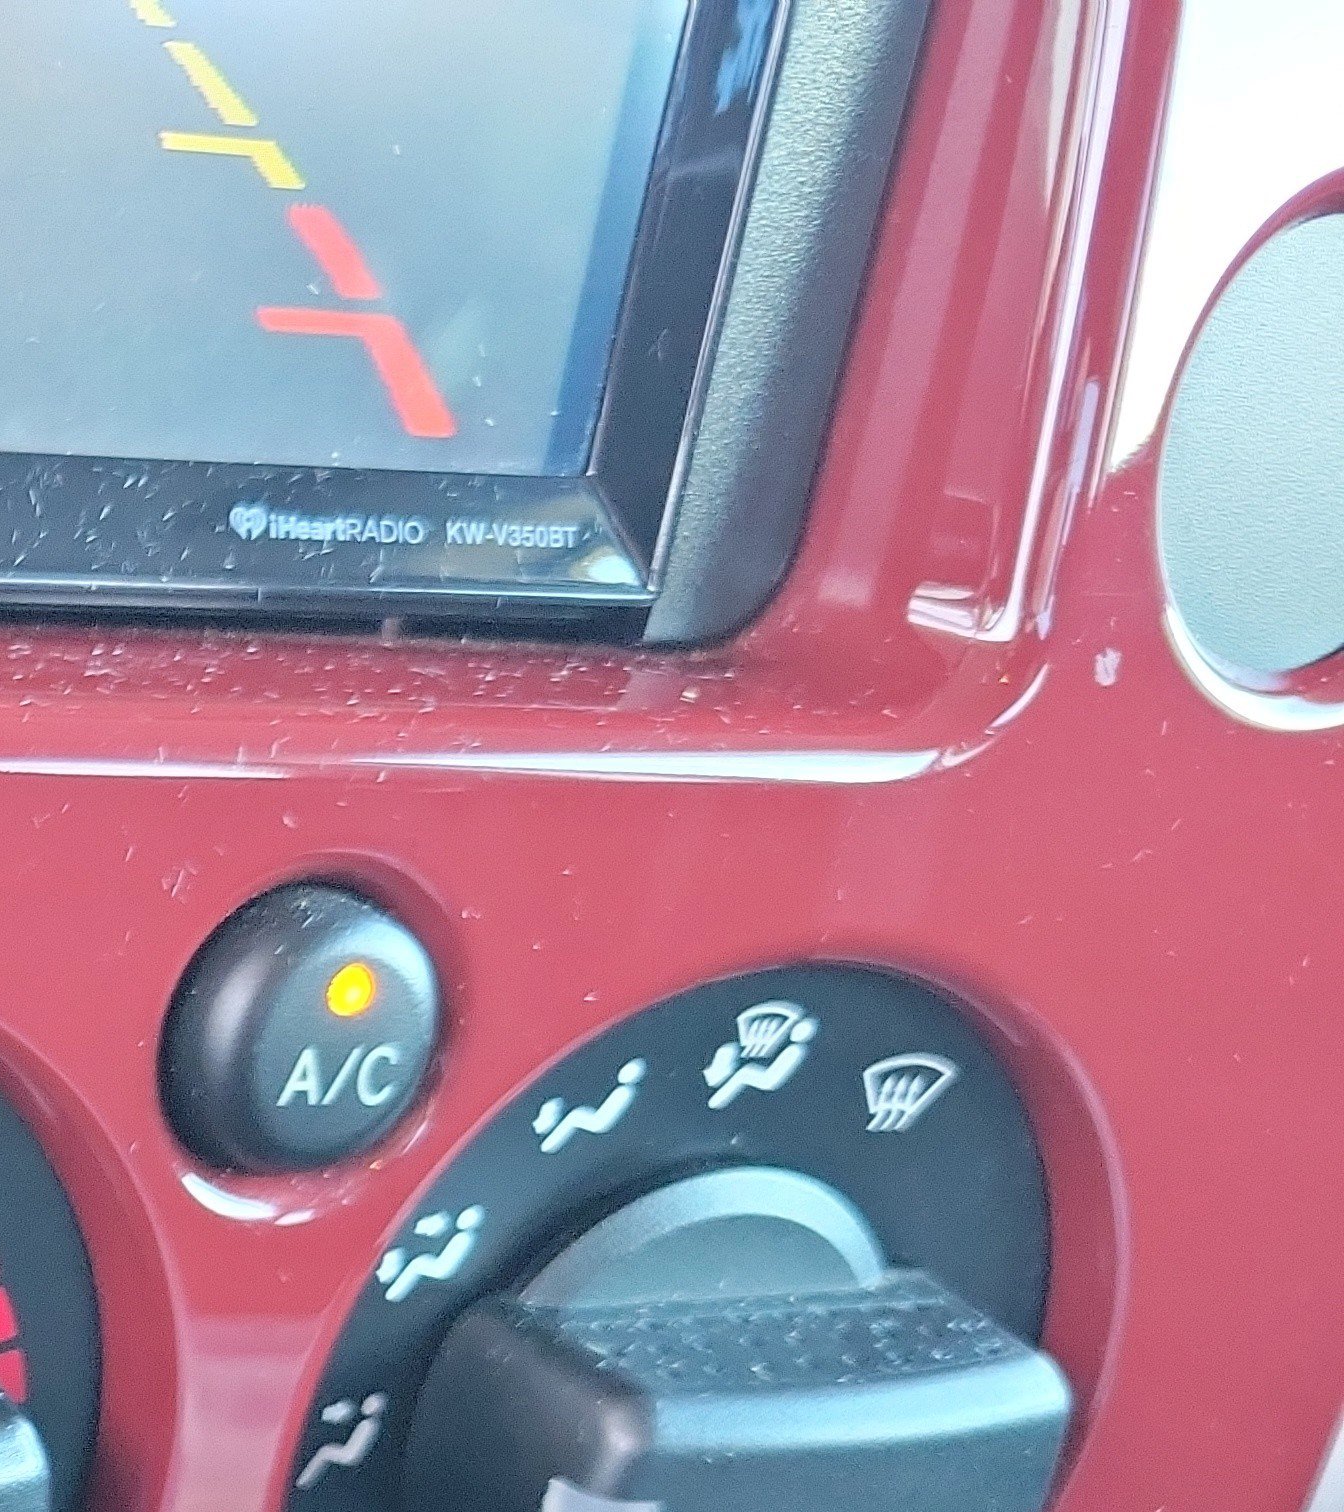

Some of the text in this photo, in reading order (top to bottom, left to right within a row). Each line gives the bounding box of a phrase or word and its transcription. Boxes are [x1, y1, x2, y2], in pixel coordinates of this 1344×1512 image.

[268, 513, 425, 545] iHeartRADIO
[445, 519, 578, 549] KW-V350BT
[276, 1042, 400, 1107] A/C
